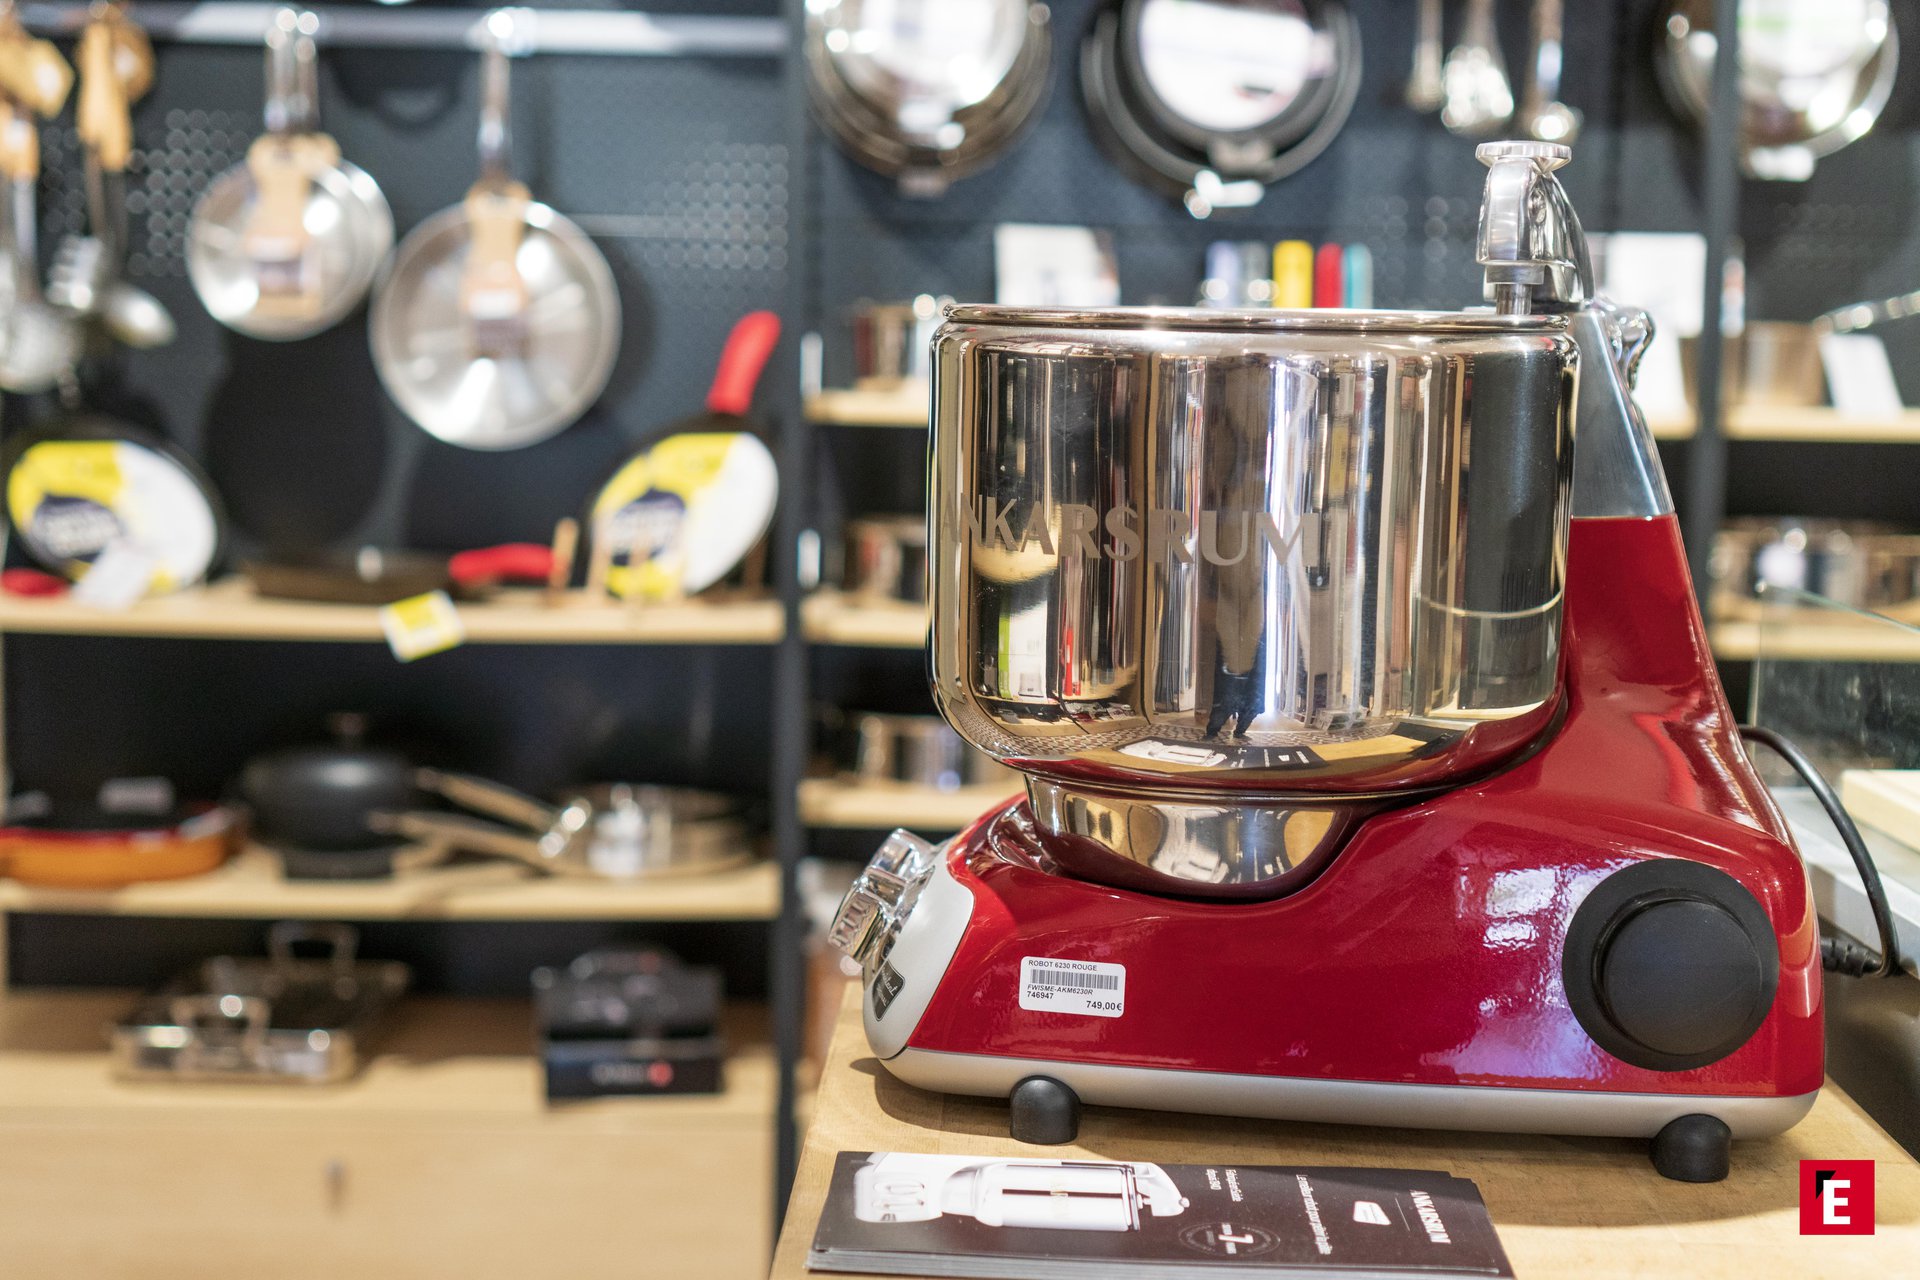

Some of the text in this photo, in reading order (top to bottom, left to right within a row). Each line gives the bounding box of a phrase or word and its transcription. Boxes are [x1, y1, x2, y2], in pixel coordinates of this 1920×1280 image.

[940, 490, 1320, 567] ANKARSRUM
[1028, 959, 1098, 972] ROBOT 6230 ROUGE
[1027, 984, 1094, 996] FWISME-AKM6230R
[1027, 991, 1054, 1000] 746947
[1086, 1000, 1122, 1012] 749,00€
